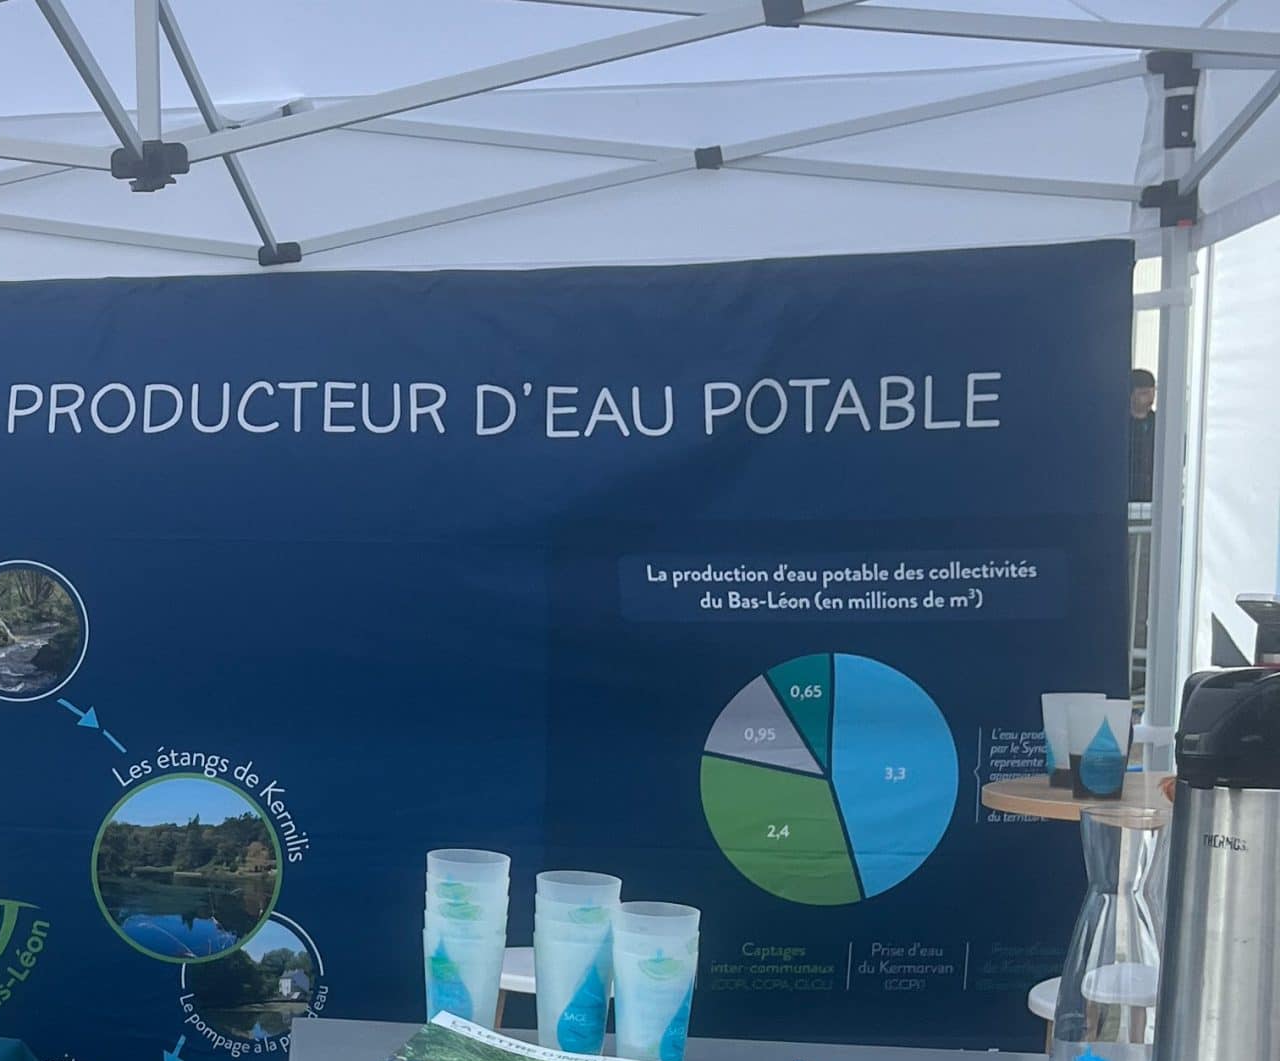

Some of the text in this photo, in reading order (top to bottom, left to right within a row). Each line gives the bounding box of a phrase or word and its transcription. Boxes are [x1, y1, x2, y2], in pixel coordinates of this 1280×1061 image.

[7, 380, 447, 437] PRODUCTEUR
[476, 381, 675, 438] D'EAU
[705, 372, 1002, 436] POTABLE
[646, 560, 1037, 588] La production d'eau potable des collectivités
[699, 591, 945, 611] du Bas-Léon (en millions de
[790, 684, 823, 702] 0,65
[744, 727, 776, 744] 0,95
[884, 767, 907, 784] 3,3
[111, 747, 310, 863] Les étangs de Kernilis
[767, 824, 790, 841] 2,4
[741, 941, 807, 960] Captages
[871, 942, 944, 958] Prise d'eau
[858, 960, 876, 976] du
[179, 992, 251, 1058] Le pompage
